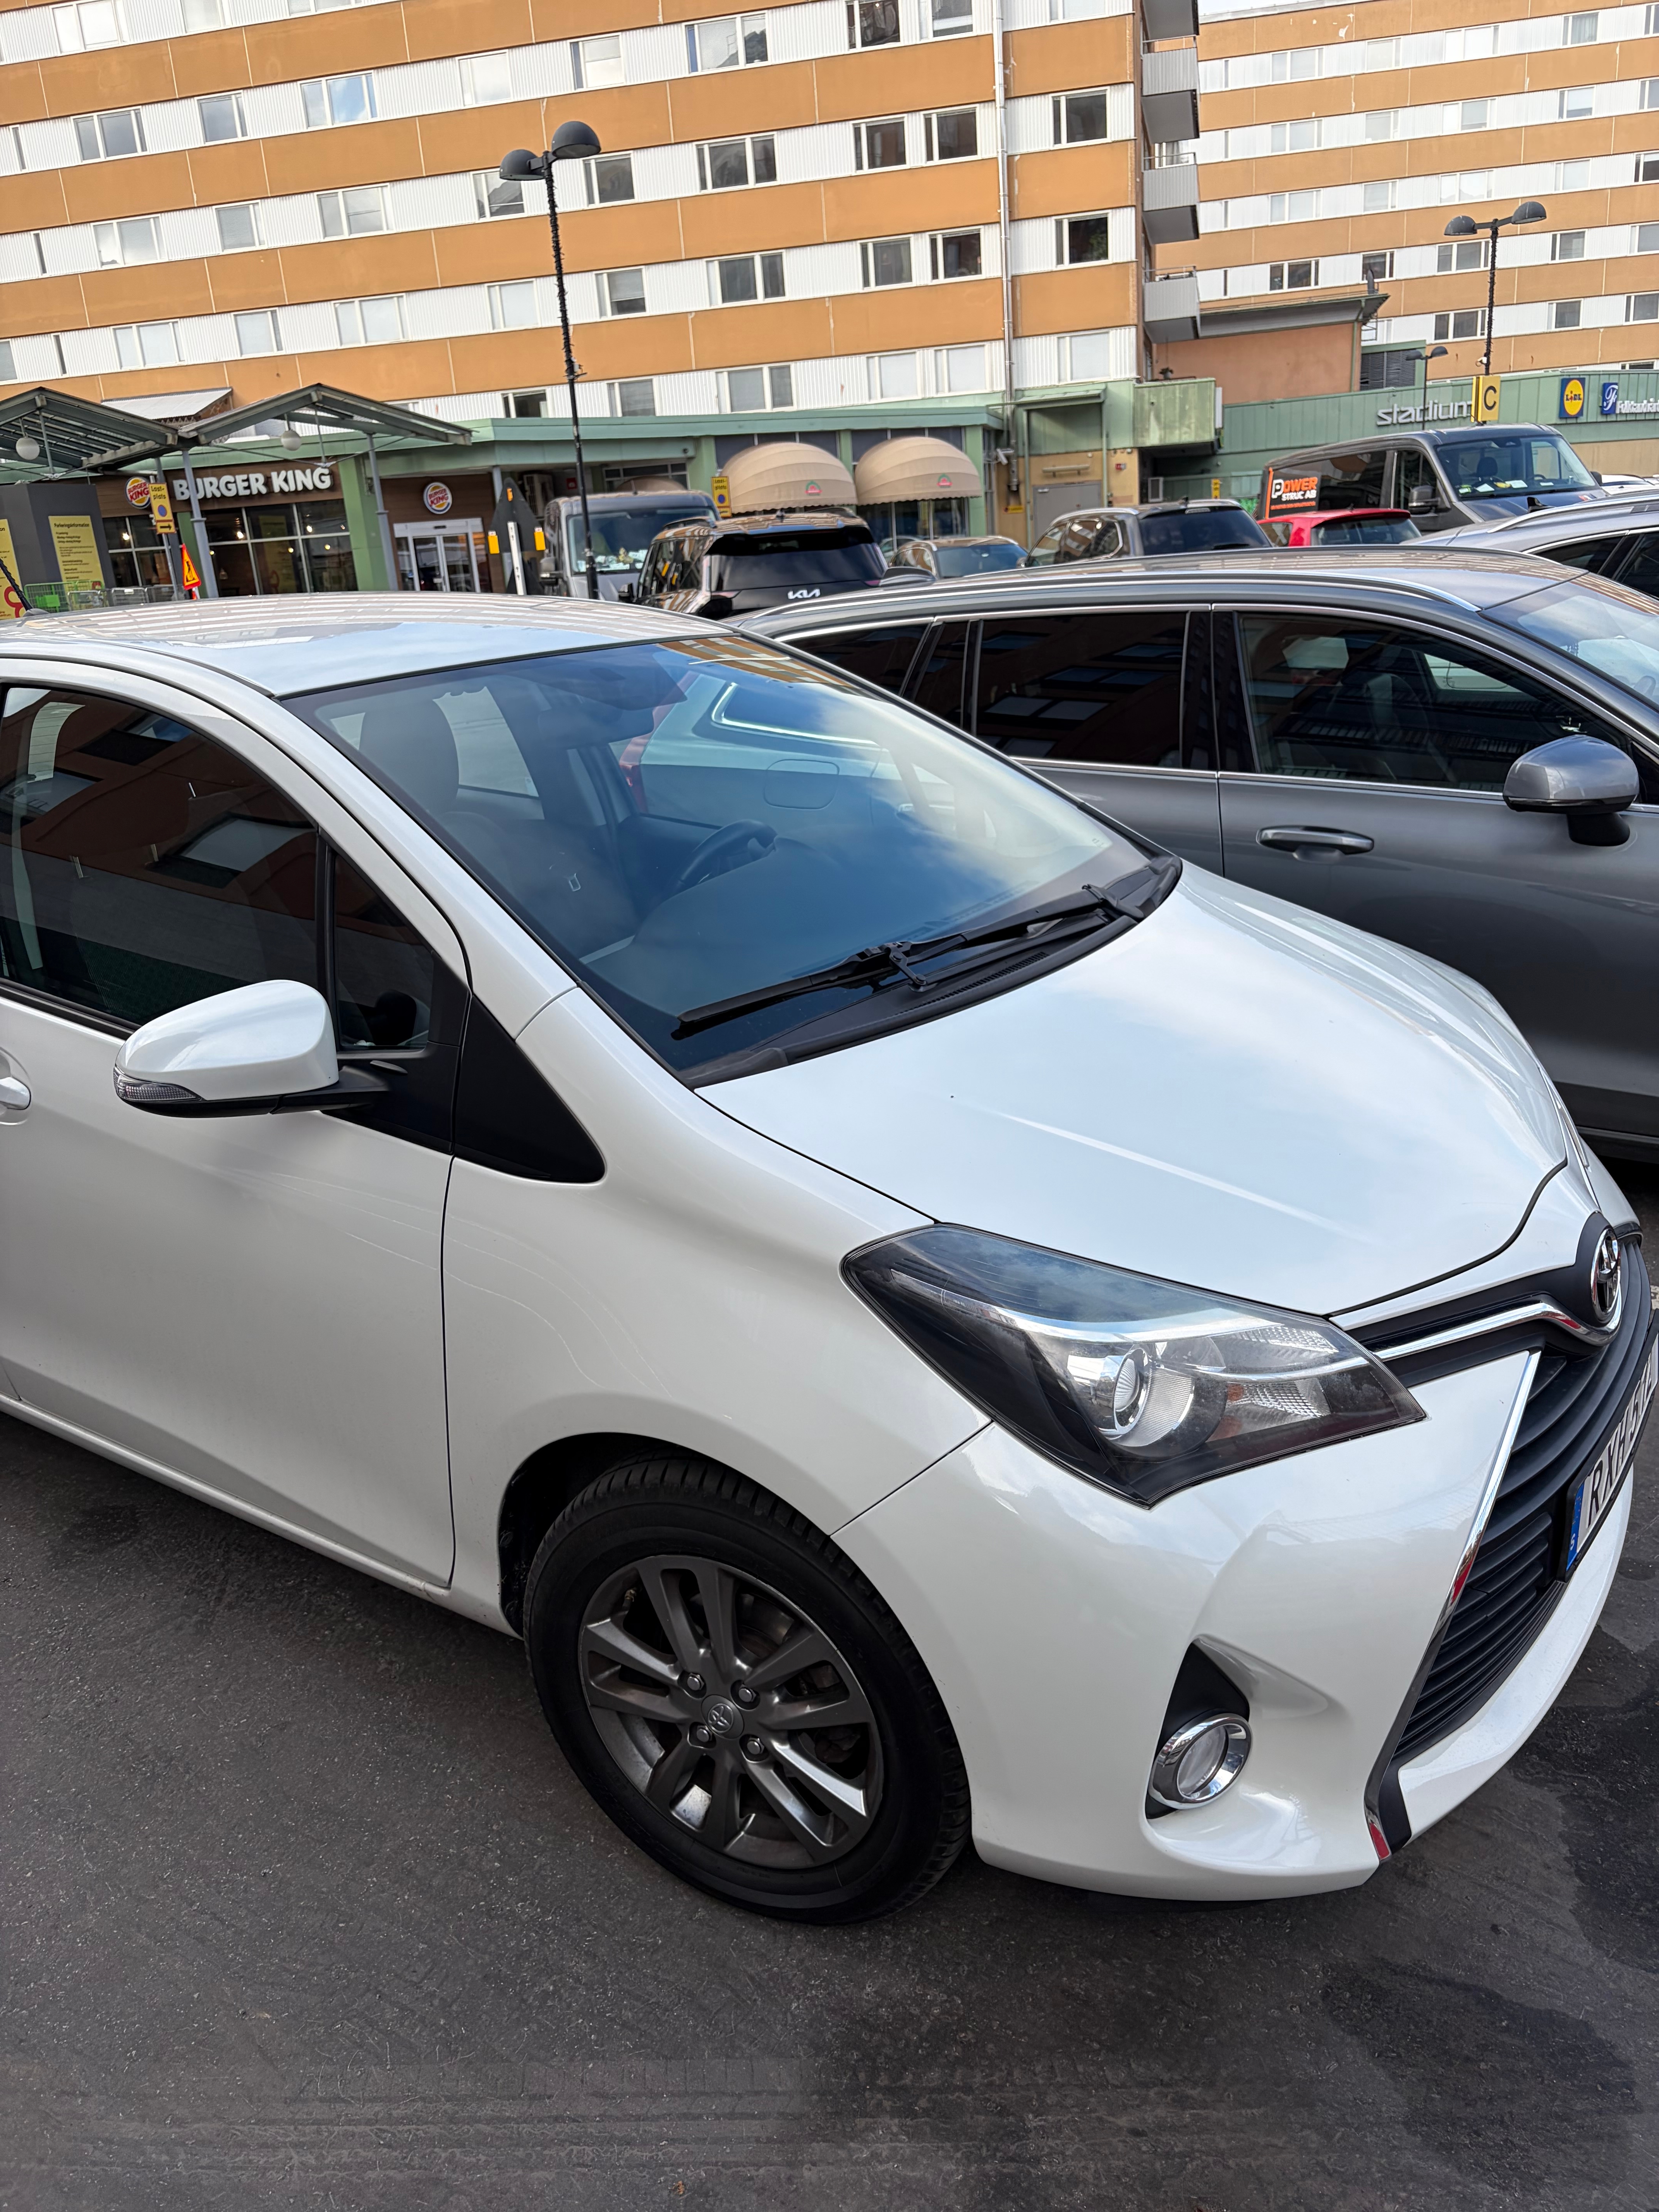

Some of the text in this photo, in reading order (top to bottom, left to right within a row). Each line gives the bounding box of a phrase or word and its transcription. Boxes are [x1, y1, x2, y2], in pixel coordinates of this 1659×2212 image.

[1484, 385, 1497, 410] C
[1377, 399, 1472, 426] stadium
[128, 481, 147, 495] BURGER
[173, 467, 331, 500] BURGER KING
[1271, 477, 1318, 498] POWER
[130, 487, 149, 502] KING
[430, 493, 449, 507] KING
[1304, 489, 1317, 499] AB
[1588, 1409, 1629, 1529] RXH
[1570, 1532, 1576, 1551] S
